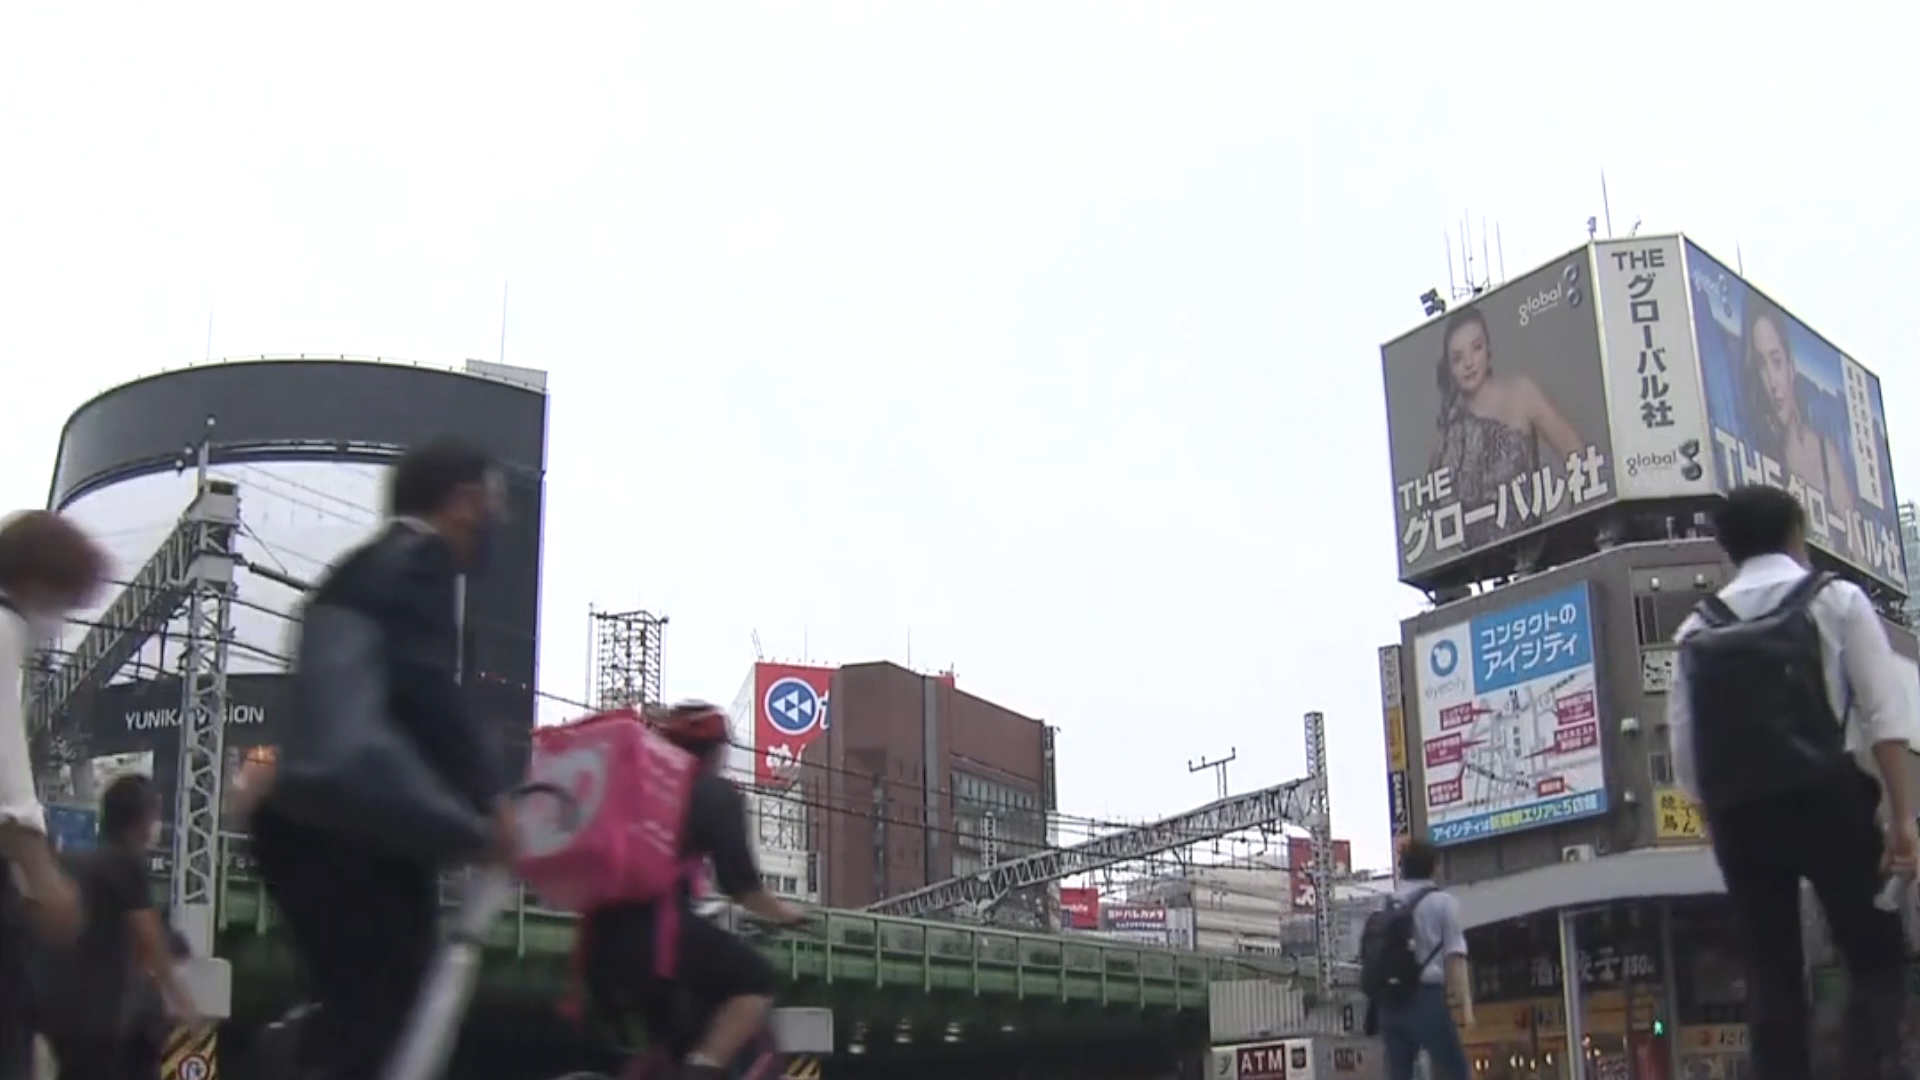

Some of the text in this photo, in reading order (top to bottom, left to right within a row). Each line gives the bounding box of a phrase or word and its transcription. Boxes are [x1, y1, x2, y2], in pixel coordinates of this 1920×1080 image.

[1611, 249, 1665, 270] THE
[1518, 283, 1562, 326] global
[1628, 272, 1674, 428] グローバル社
[1626, 450, 1677, 477] global
[1399, 466, 1452, 511] THE
[1403, 445, 1609, 564] グローバル社
[1481, 603, 1576, 650] コンタクトの
[1482, 632, 1577, 682] アイシティ
[1241, 1049, 1283, 1074] ATM
